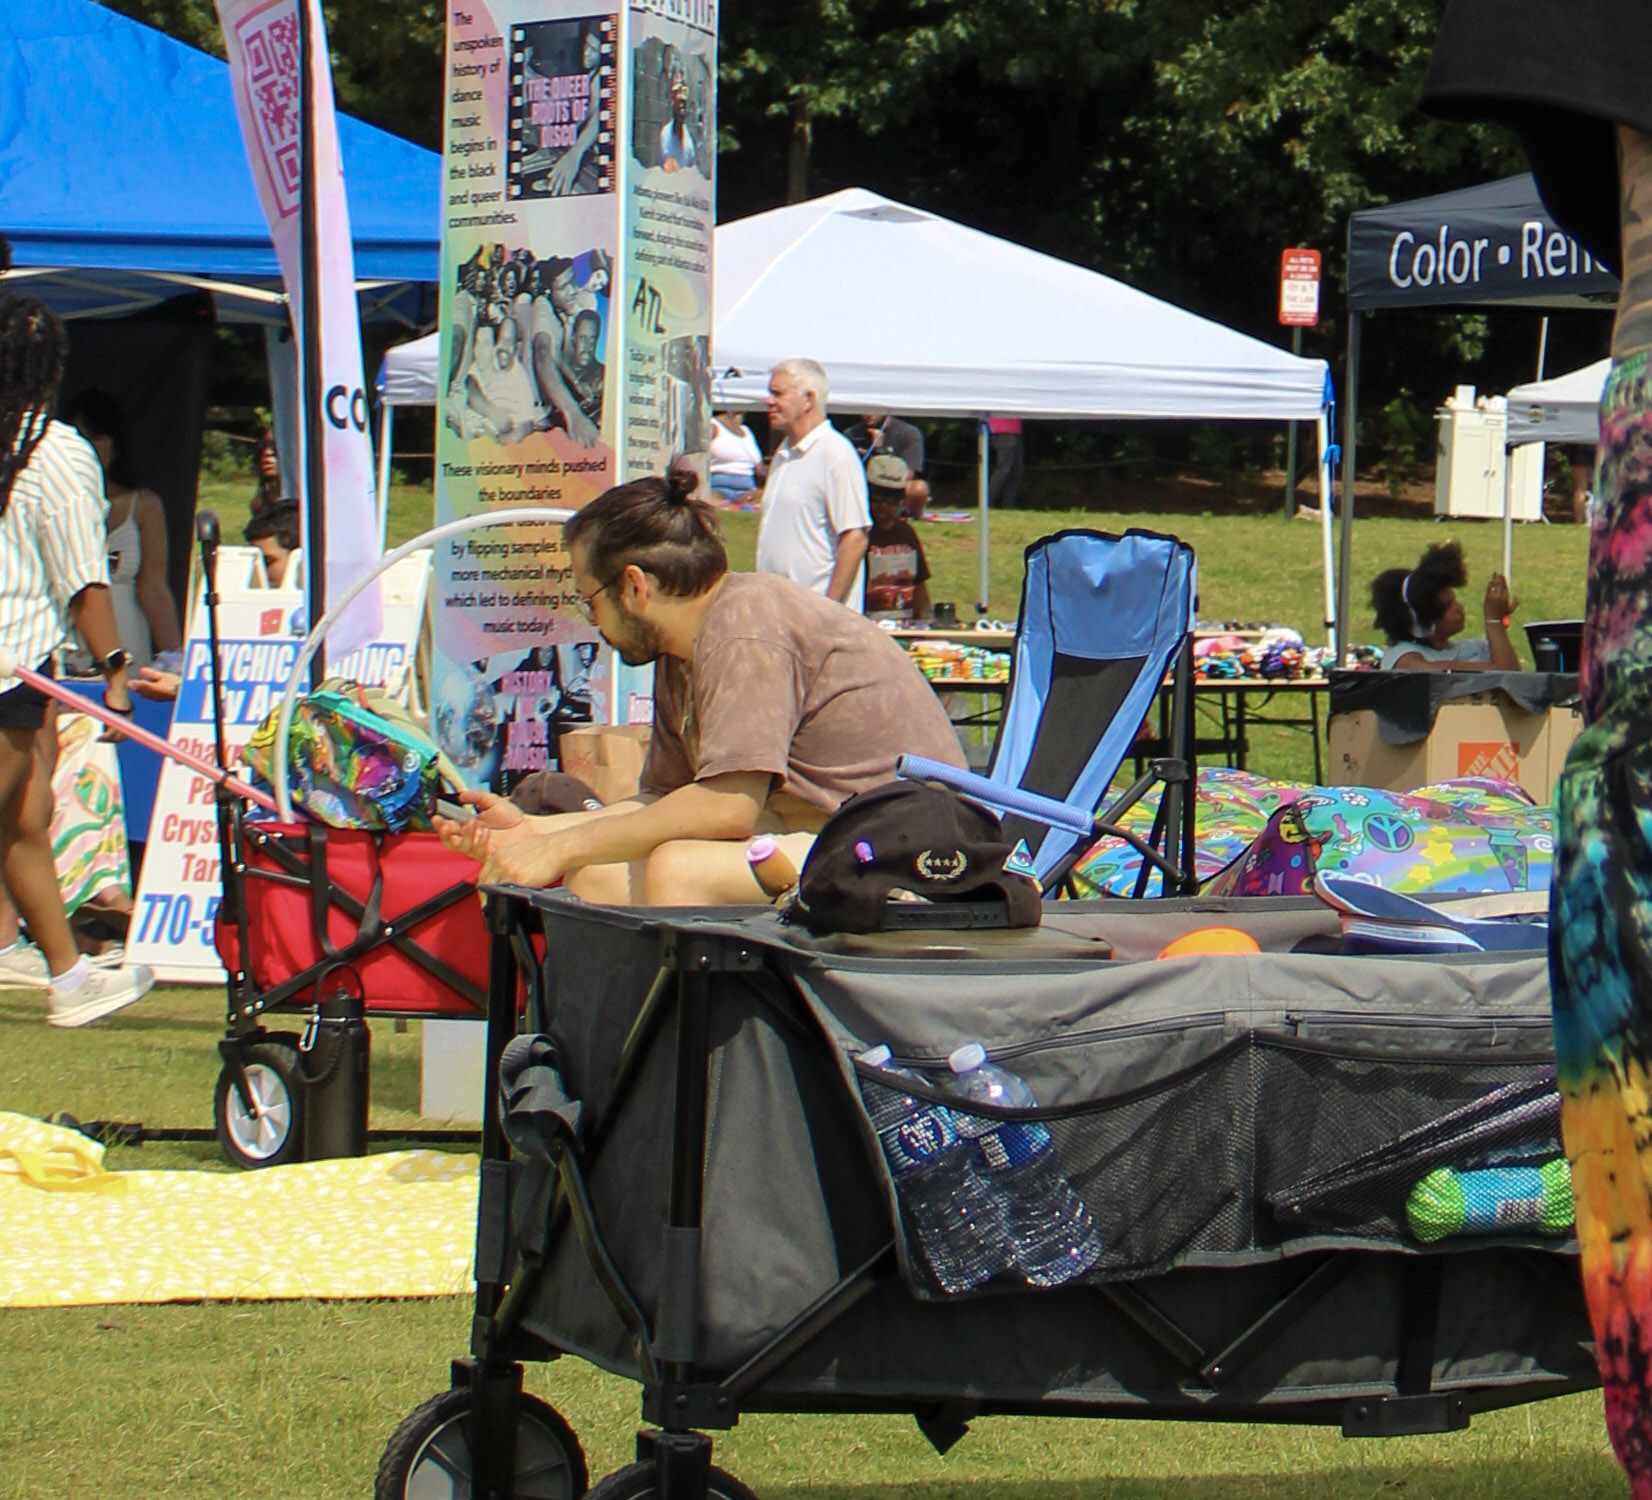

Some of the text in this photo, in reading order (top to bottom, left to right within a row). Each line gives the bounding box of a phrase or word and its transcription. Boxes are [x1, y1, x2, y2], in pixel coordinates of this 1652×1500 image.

[454, 11, 473, 25] The
[454, 34, 503, 52] unspoken
[453, 58, 501, 79] history of
[452, 88, 482, 103] dance
[527, 74, 590, 101] THE QUEER
[451, 112, 481, 127] music
[451, 138, 497, 156] begins in
[450, 162, 497, 180] the black
[448, 190, 502, 208] and queer
[448, 210, 519, 230] communities.
[1388, 224, 1489, 289] Color
[632, 276, 667, 334] ATL
[442, 457, 607, 478] These visionary minds pushed
[478, 486, 562, 502] the boundaries
[451, 541, 465, 559] by
[467, 539, 509, 557] flipping
[511, 538, 559, 557] samples
[452, 569, 479, 581] more
[482, 566, 544, 581] mechanical
[445, 592, 476, 608] which
[478, 591, 497, 607] led
[498, 594, 511, 607] to
[512, 591, 559, 609] defining
[482, 617, 554, 636] music today!
